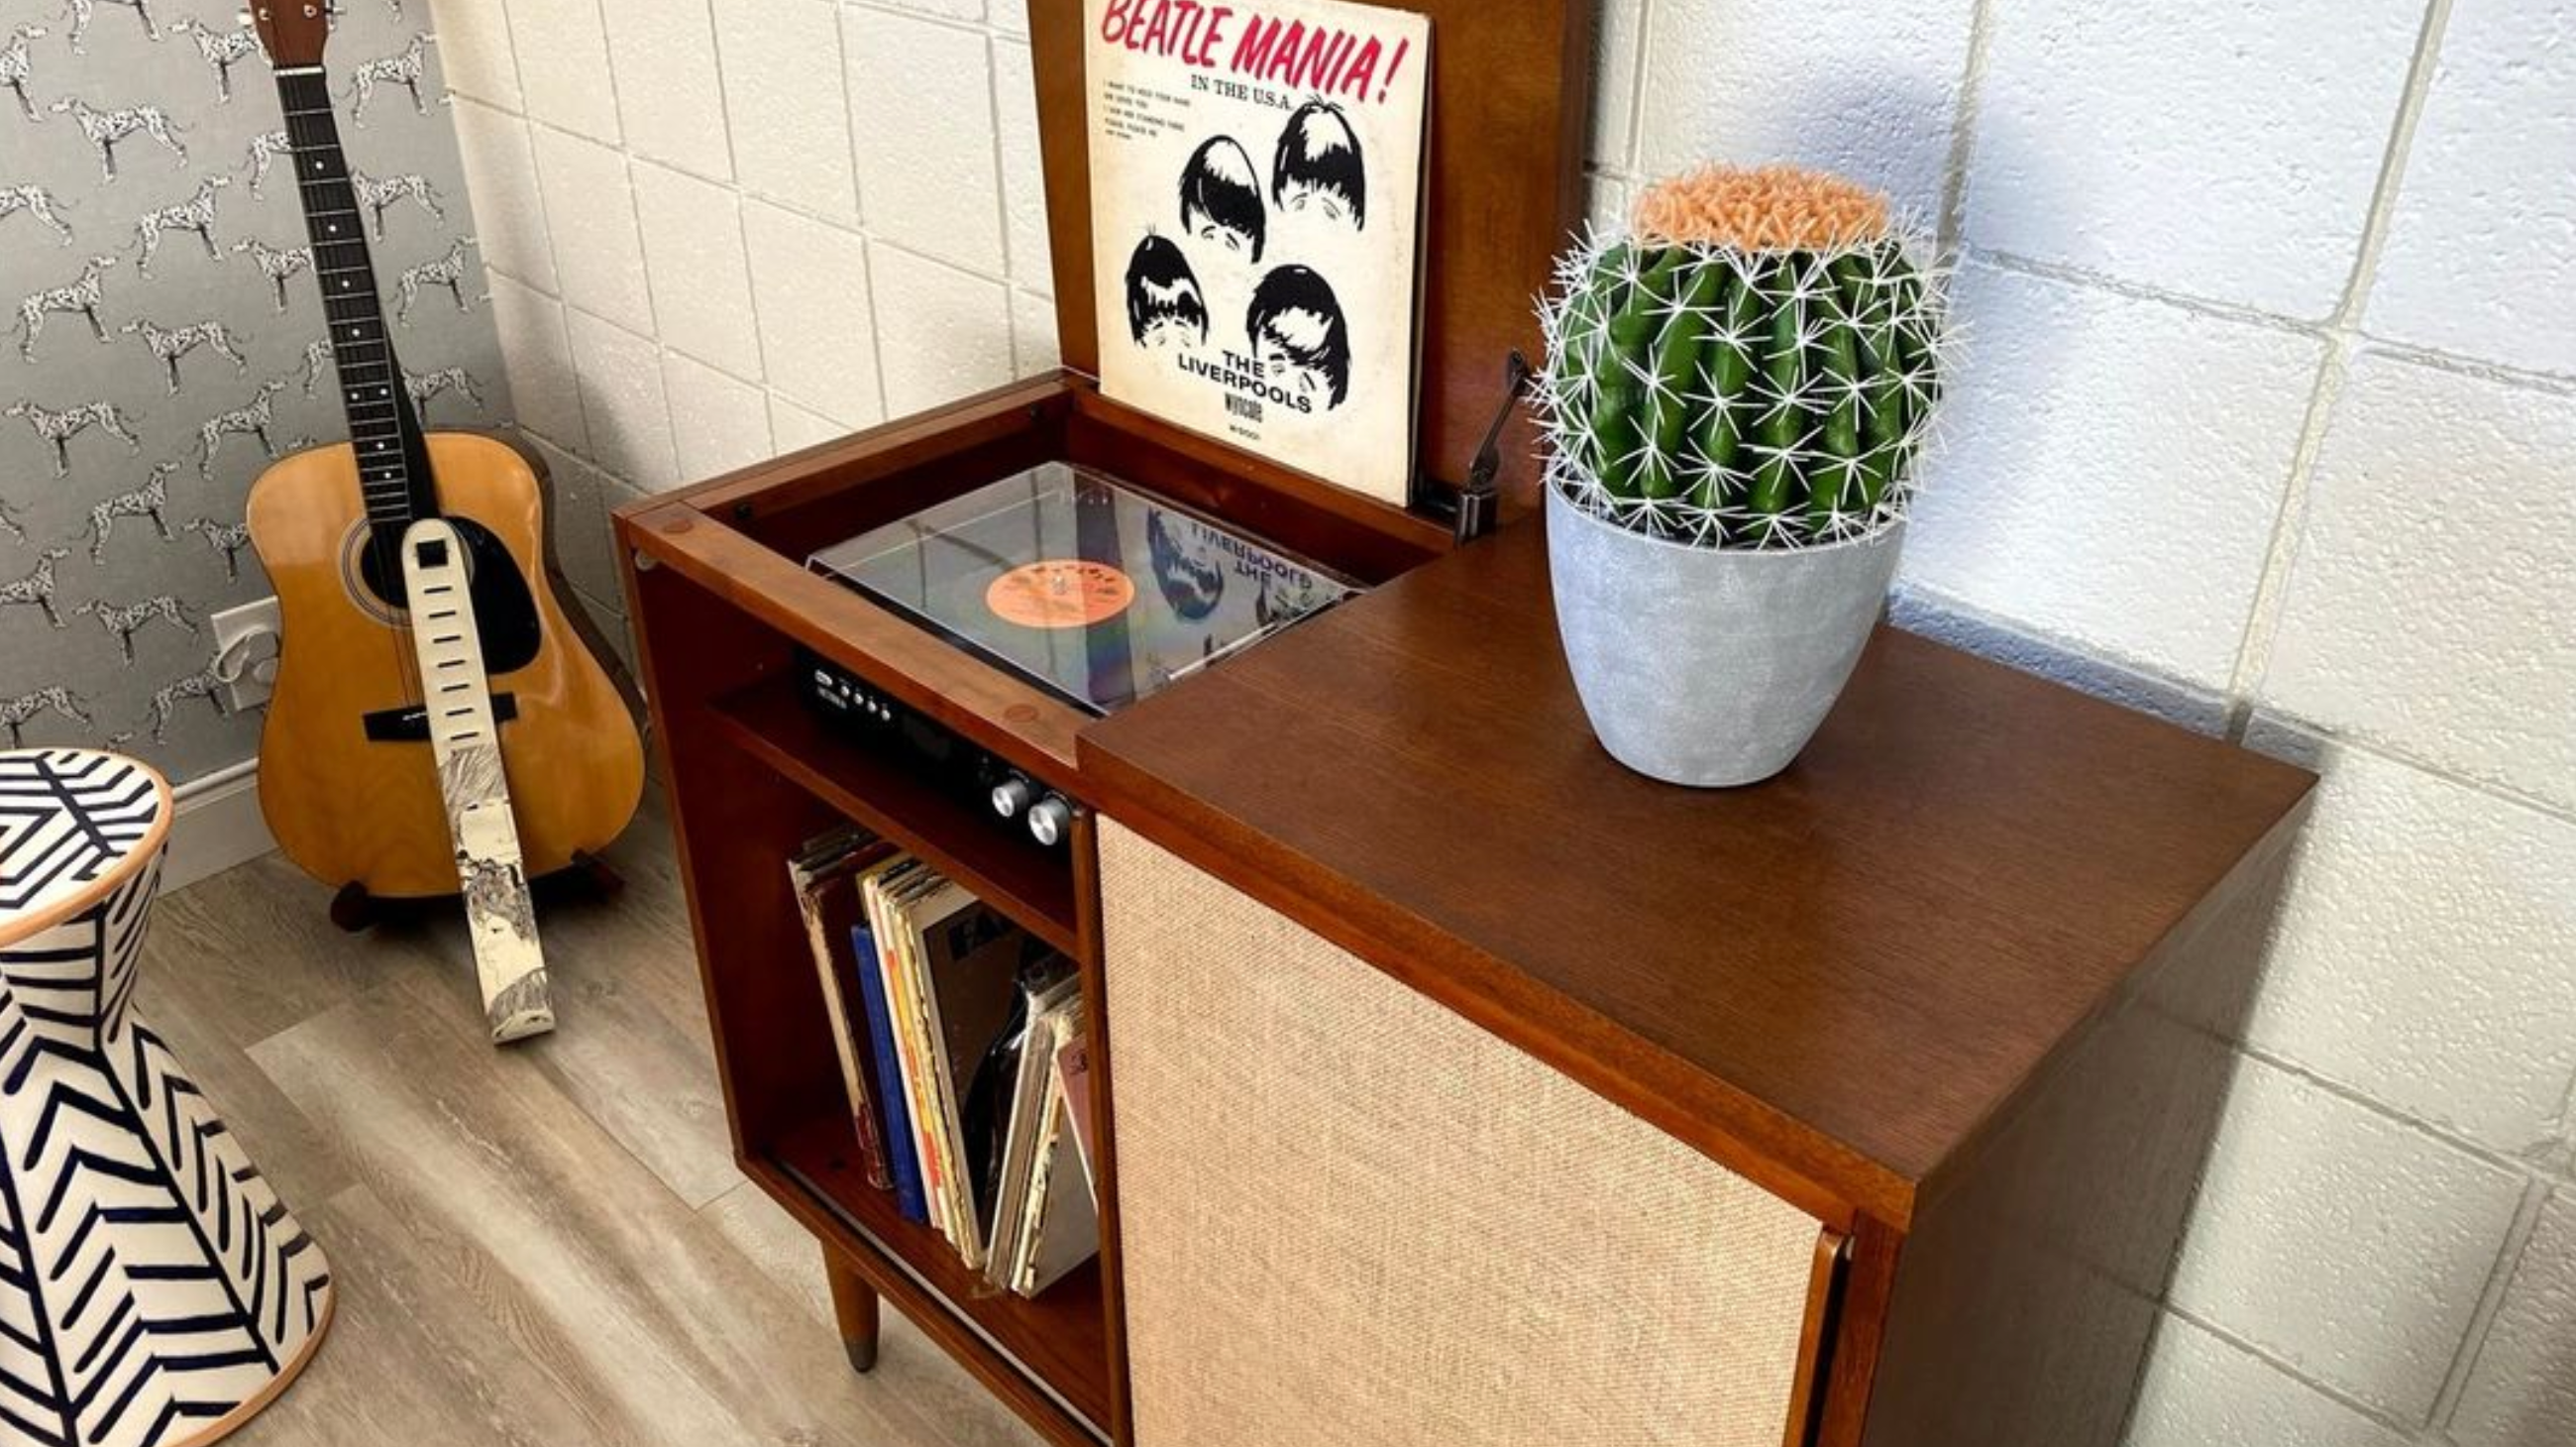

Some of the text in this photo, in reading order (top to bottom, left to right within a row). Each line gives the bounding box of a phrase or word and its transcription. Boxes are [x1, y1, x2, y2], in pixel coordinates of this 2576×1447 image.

[1102, 0, 1410, 104] BEATLE MANIA!
[1191, 74, 1209, 91] IN
[1213, 78, 1248, 101] THE
[1178, 353, 1313, 413] LIVERPOOLS
[1222, 350, 1265, 379] THE
